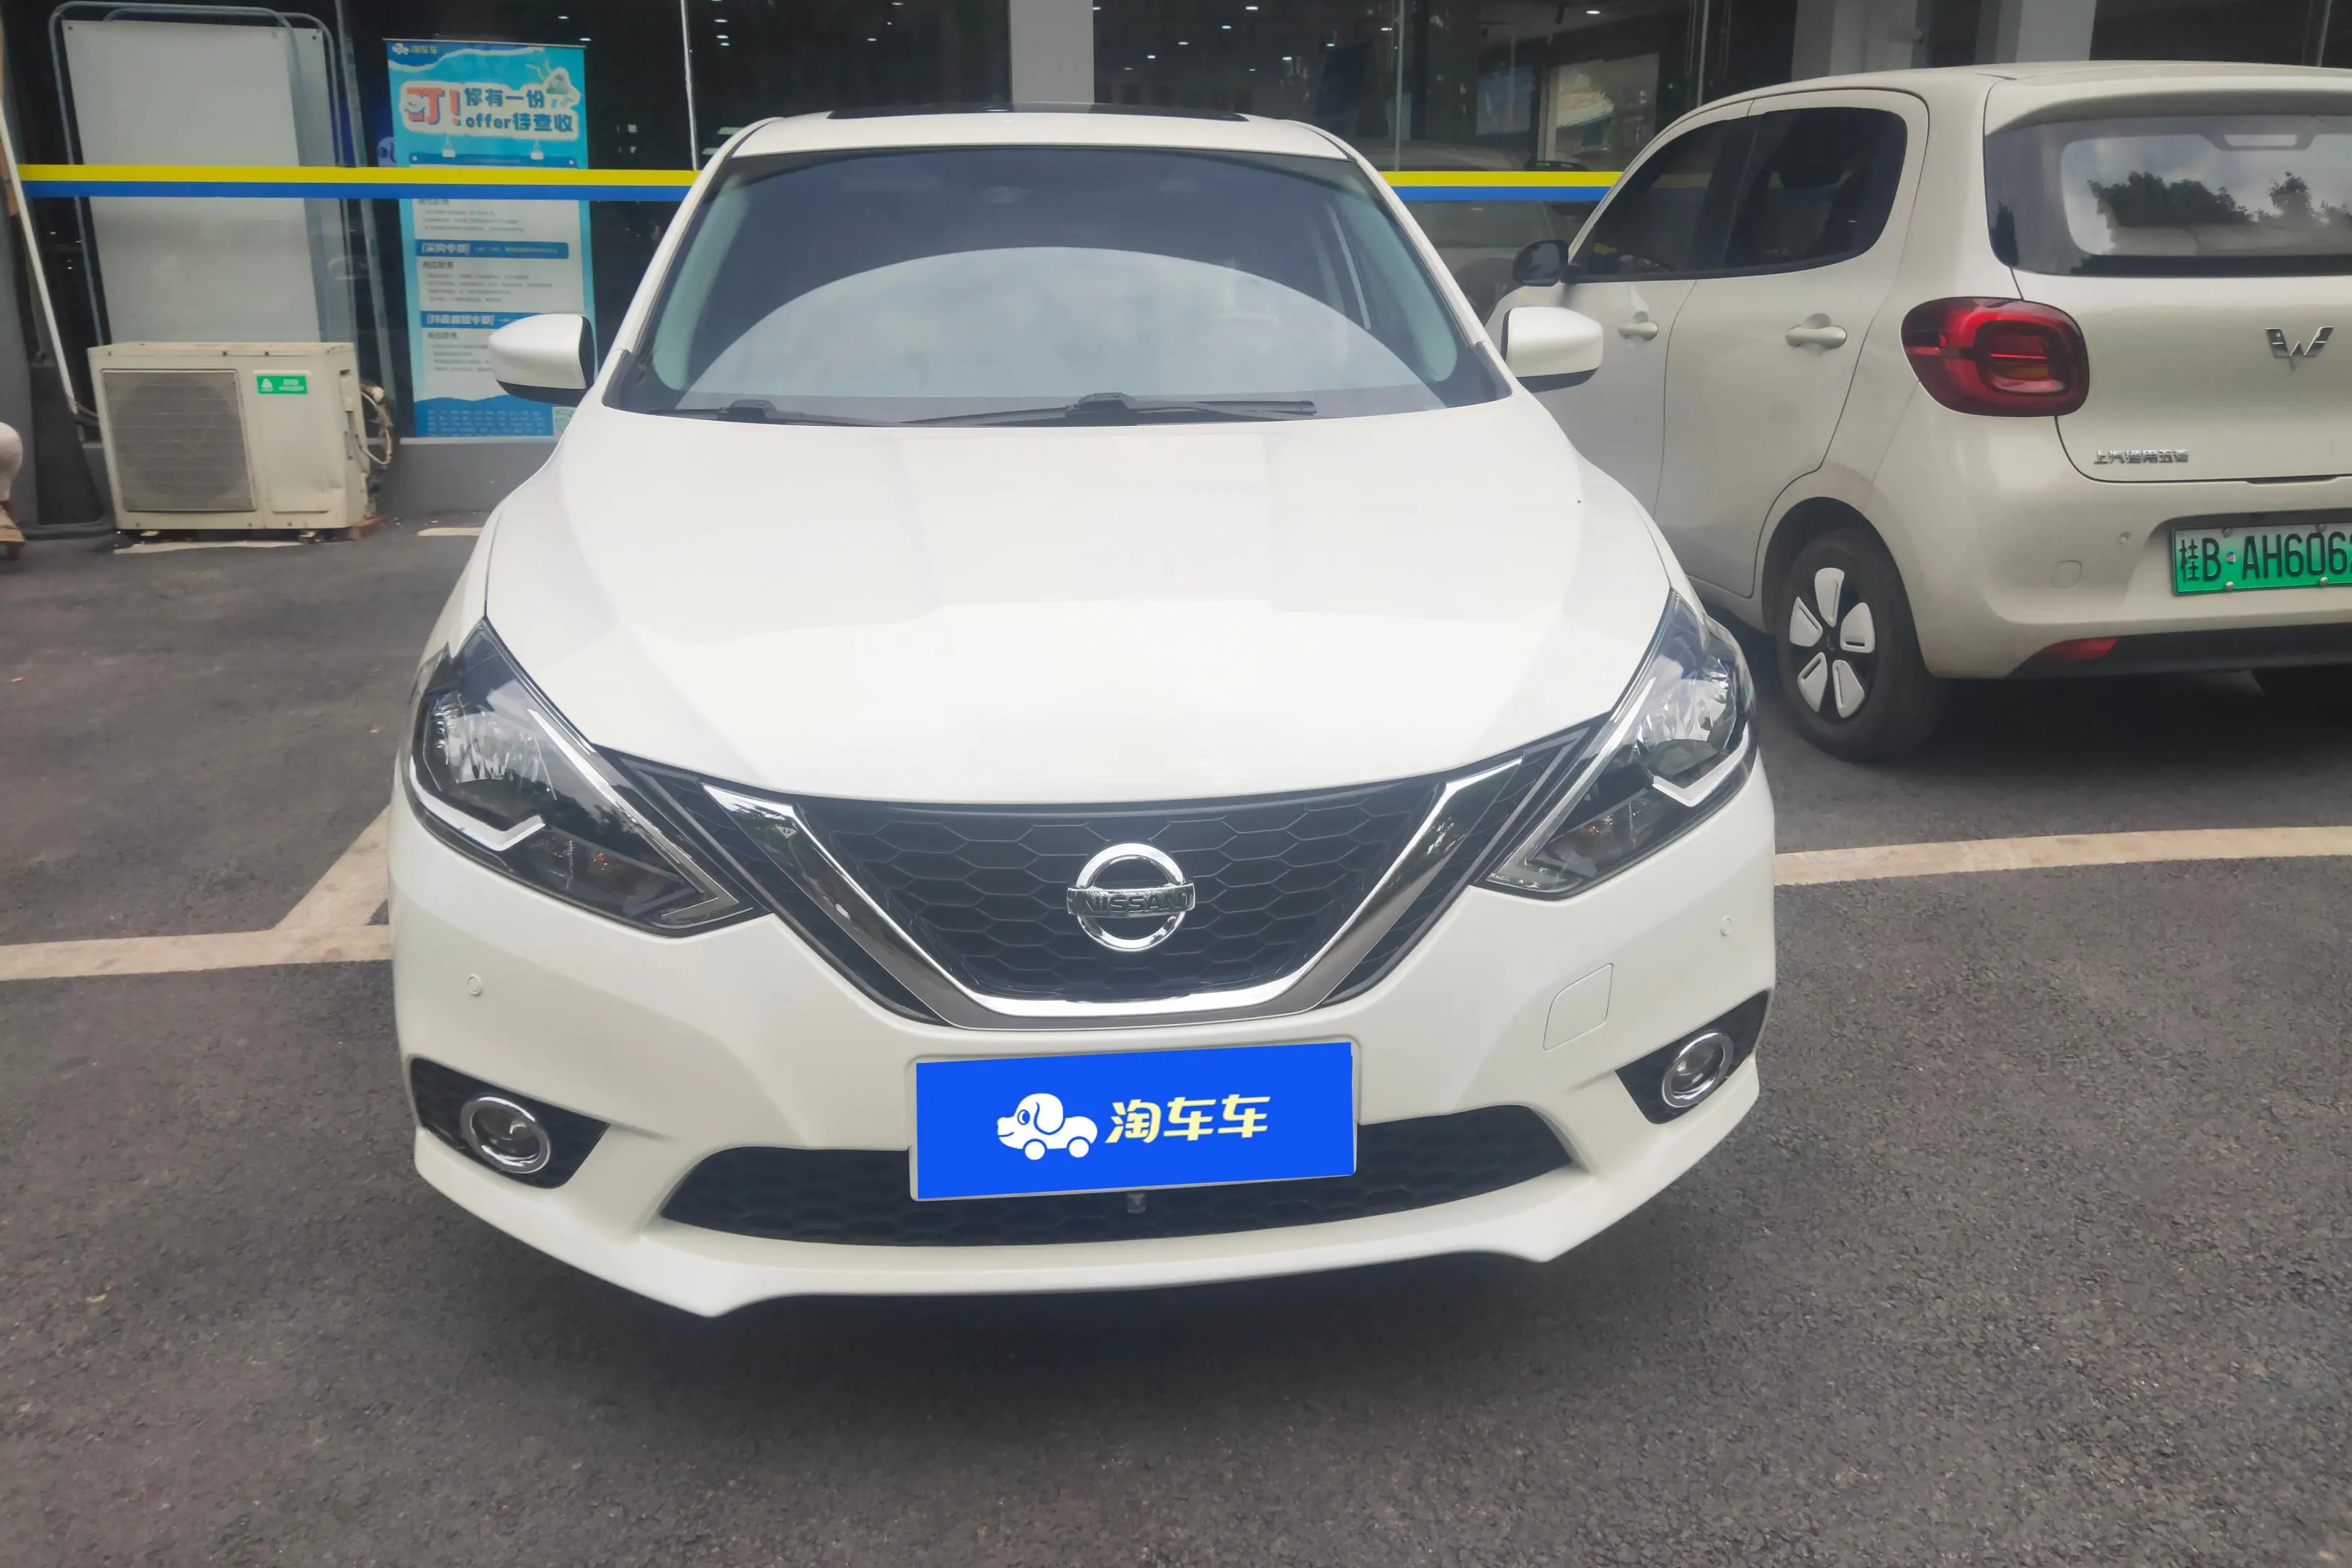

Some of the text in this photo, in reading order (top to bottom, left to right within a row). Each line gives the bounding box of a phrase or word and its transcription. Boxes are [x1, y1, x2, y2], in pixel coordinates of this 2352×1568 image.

[464, 87, 545, 108] 你有一份
[1081, 892, 1187, 917] NISSAN
